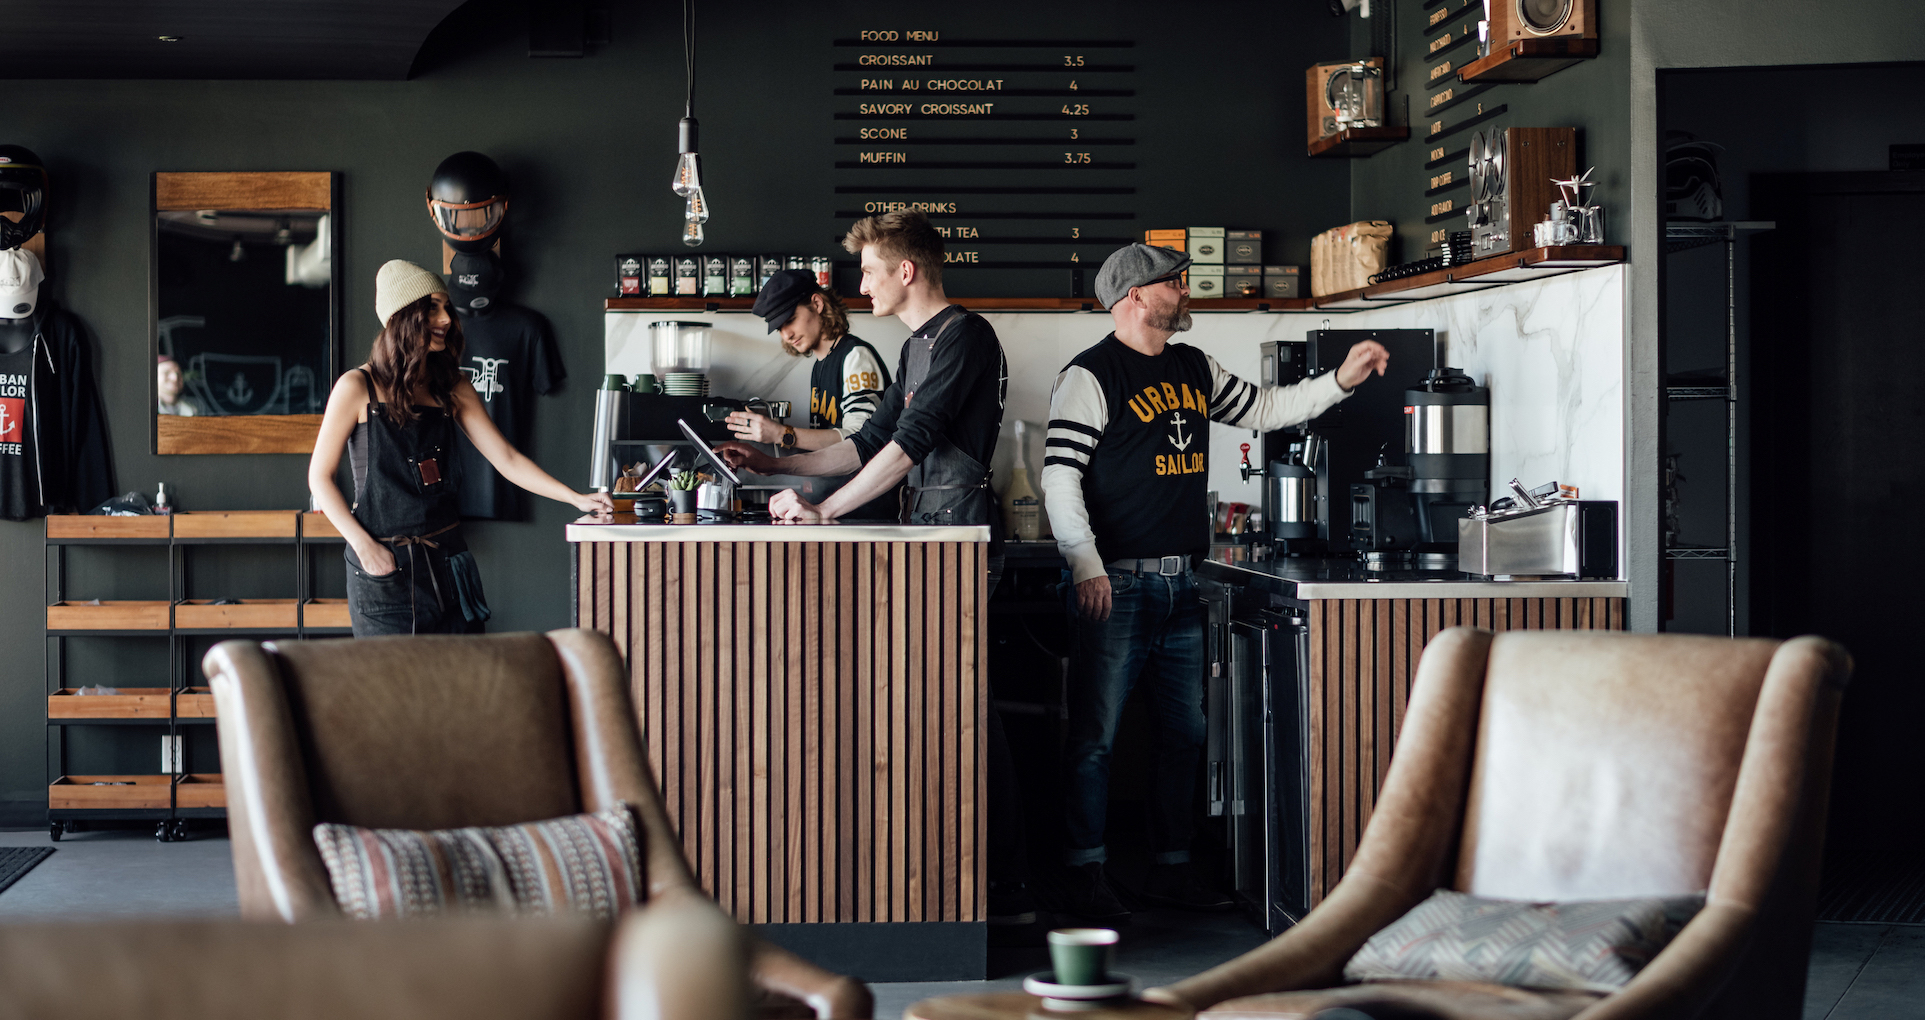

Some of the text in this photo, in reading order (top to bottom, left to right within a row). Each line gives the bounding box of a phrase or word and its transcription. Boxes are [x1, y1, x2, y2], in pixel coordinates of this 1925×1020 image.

[861, 31, 939, 42] FOOD MENU
[859, 54, 1085, 67] CROISSANT 3.5
[861, 79, 1078, 91] PAIN AU CHOCOLAT 4
[860, 103, 1090, 116] SAVORY CROISSANT 4.25
[860, 128, 1079, 140] SCONE 3
[860, 152, 1092, 164] MUFFIN 3.75
[864, 202, 957, 214] OTHER DRINKS
[956, 227, 979, 239] TEA
[1071, 227, 1080, 239] 3
[1070, 252, 1079, 263] 4
[845, 371, 879, 393] 1999
[1, 385, 26, 398] LOR
[1127, 381, 1208, 423] URBAN
[1155, 452, 1205, 476] SAILOR
